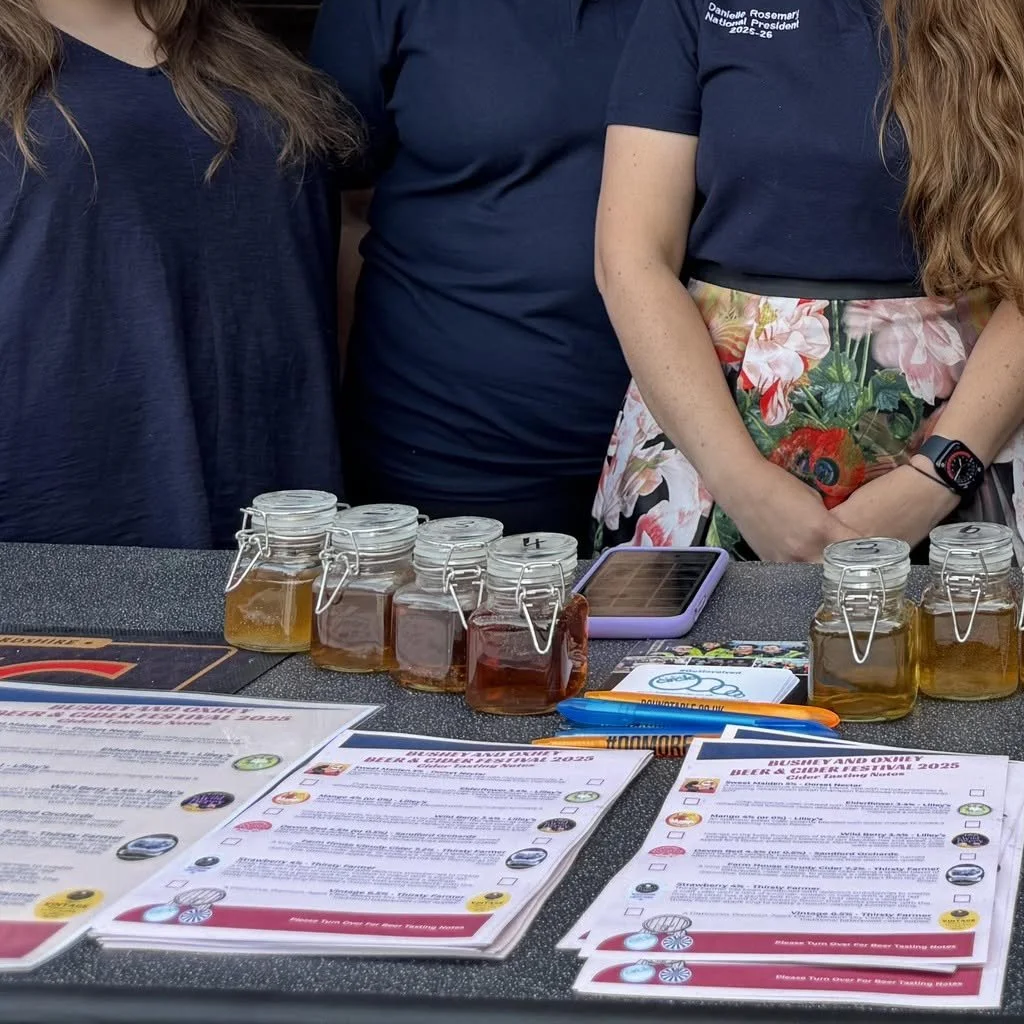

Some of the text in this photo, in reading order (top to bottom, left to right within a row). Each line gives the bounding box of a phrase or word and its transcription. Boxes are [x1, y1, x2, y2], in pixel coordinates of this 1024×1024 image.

[708, 2, 746, 19] Danielle
[704, 11, 800, 31] National President
[728, 26, 773, 39] 2025-26
[522, 536, 547, 550] 4
[0, 636, 79, 646] RDSHIRE
[138, 713, 232, 721] FESTIVAL
[841, 765, 914, 773] FESTIVAL
